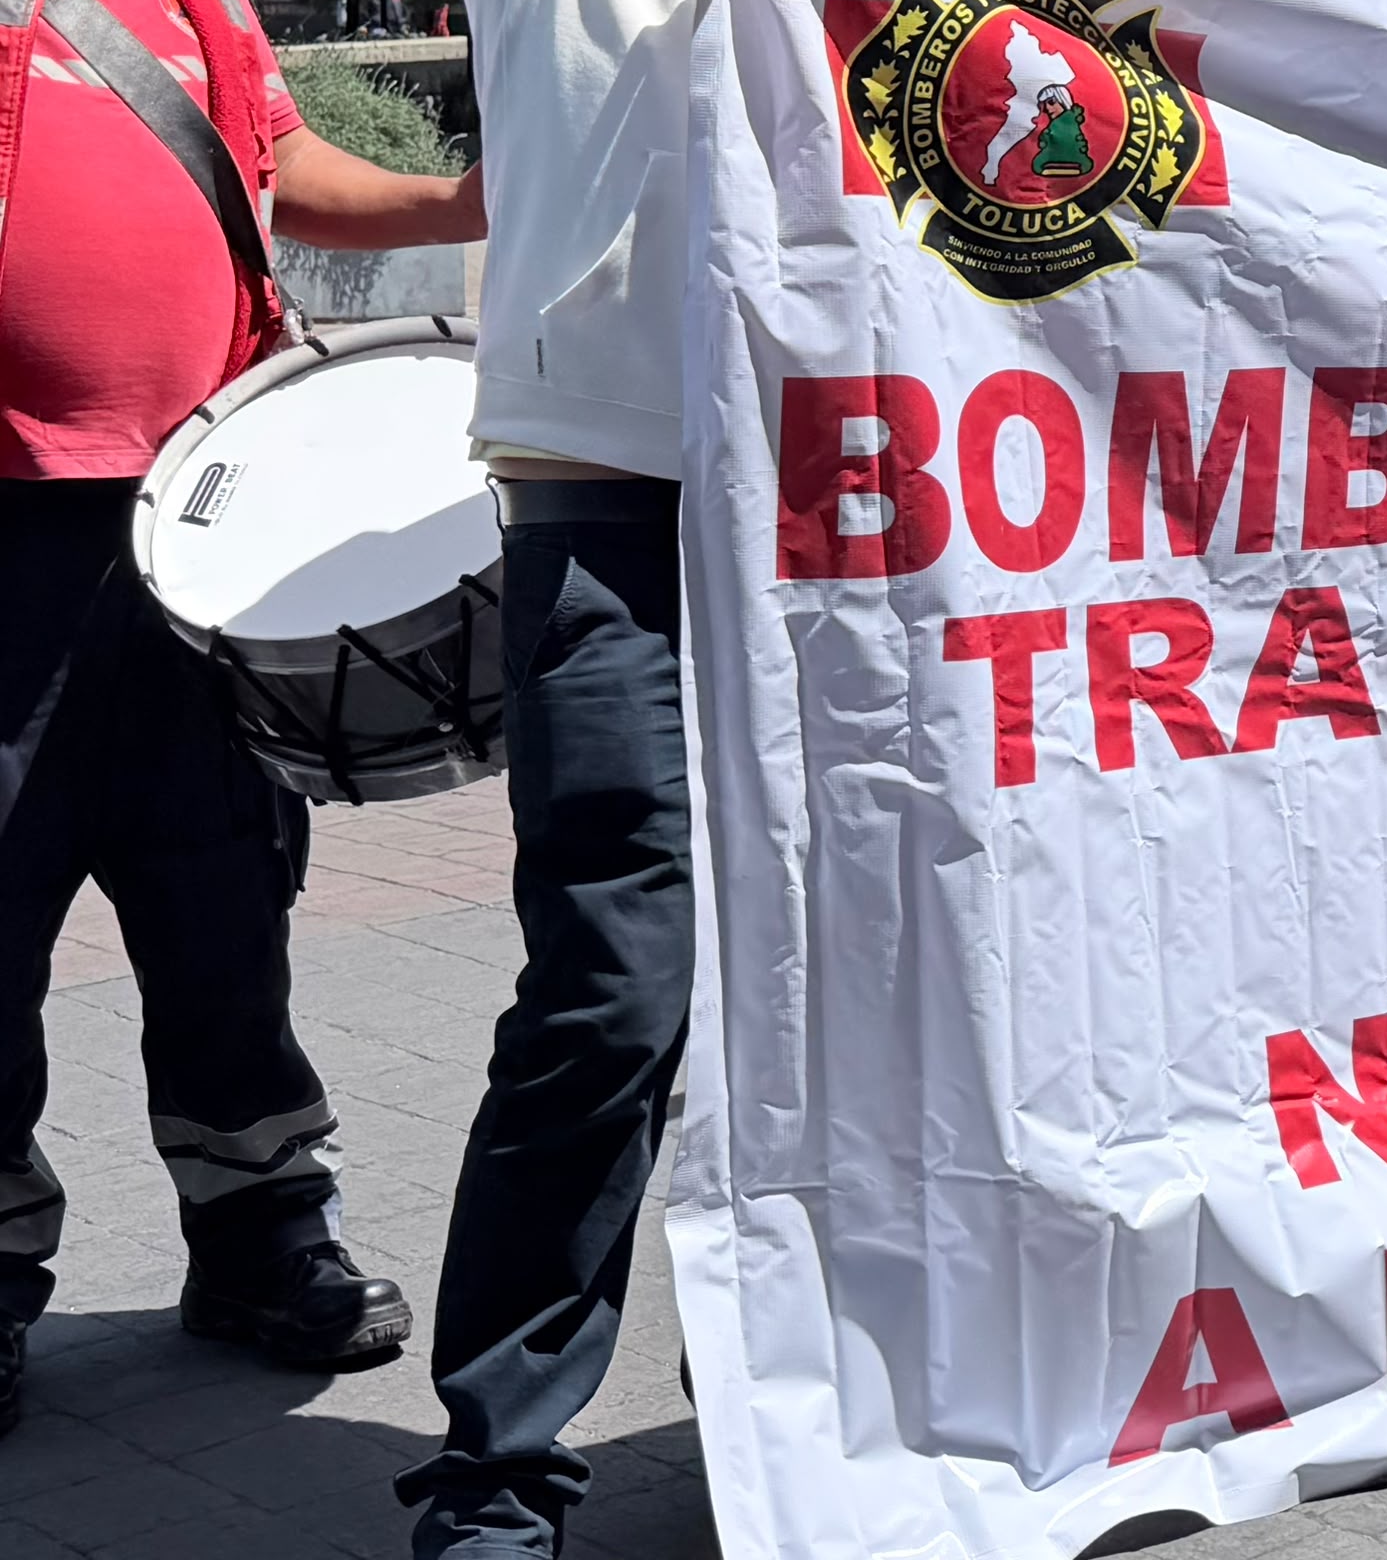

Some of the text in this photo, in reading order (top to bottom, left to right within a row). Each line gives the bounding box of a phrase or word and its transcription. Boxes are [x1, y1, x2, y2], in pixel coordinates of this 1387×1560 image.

[912, 6, 975, 170] BOMBEROS
[1117, 96, 1149, 171] CIVIL
[961, 192, 1087, 235] TOLUCA
[943, 248, 965, 264] CON
[1015, 252, 1028, 262] LA
[1107, 1286, 1295, 1469] A
